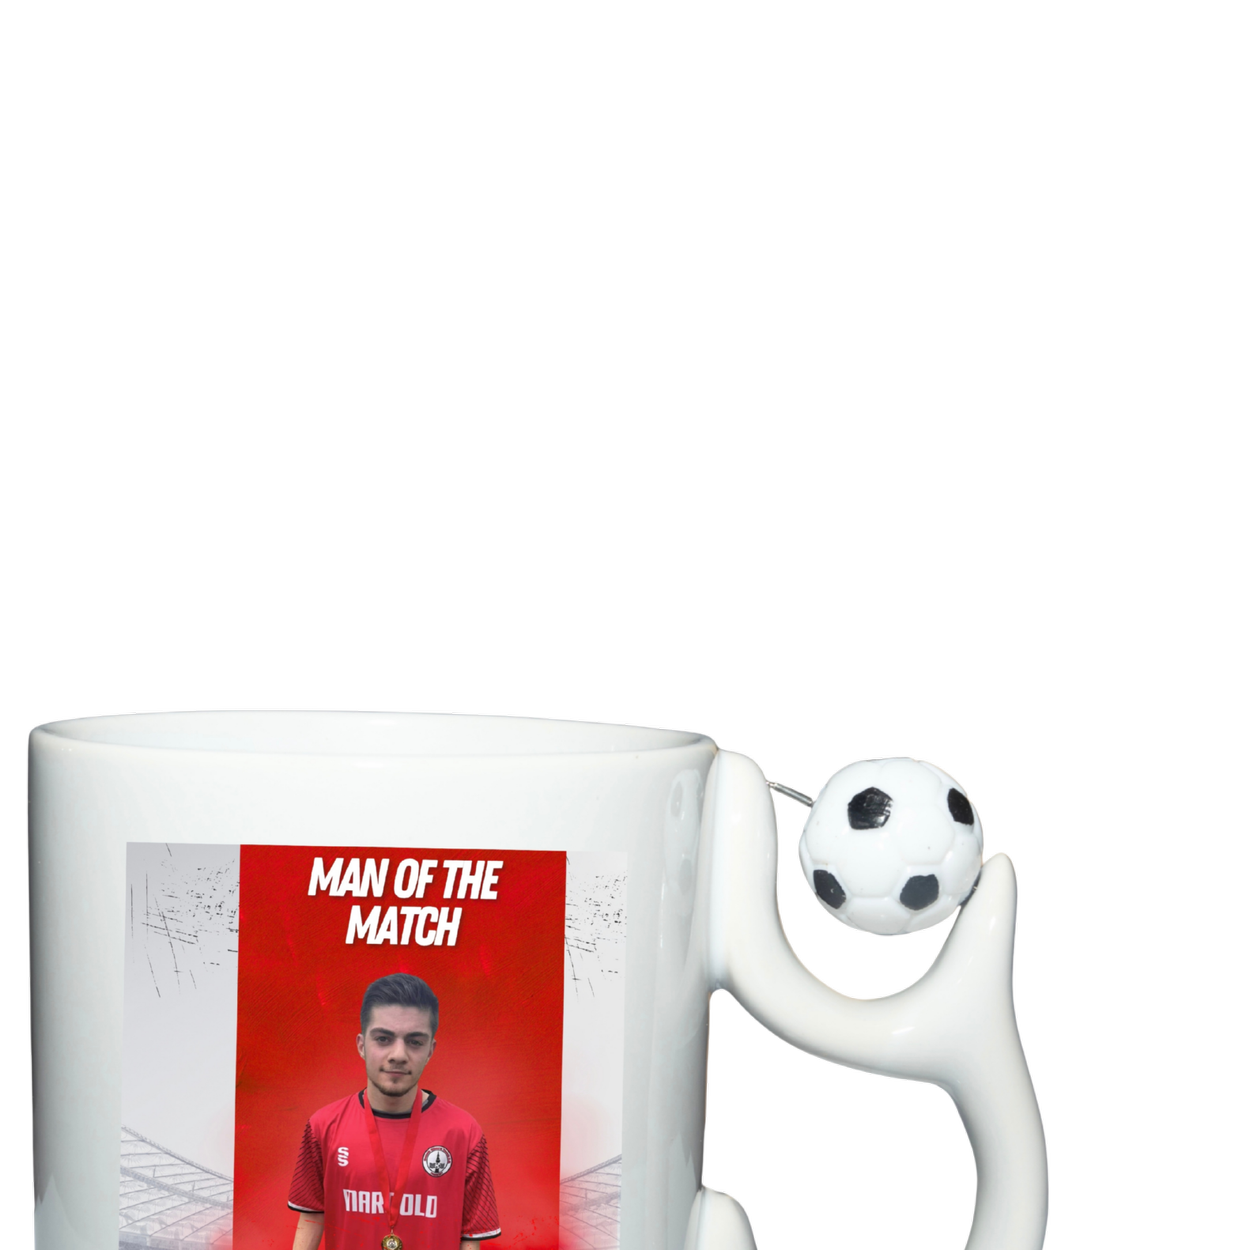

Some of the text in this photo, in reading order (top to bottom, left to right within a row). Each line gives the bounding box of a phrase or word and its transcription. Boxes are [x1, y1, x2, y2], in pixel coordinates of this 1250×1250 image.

[307, 857, 504, 900] MAN OF THE
[345, 904, 463, 947] MATCH
[342, 1188, 438, 1219] MAROLD
